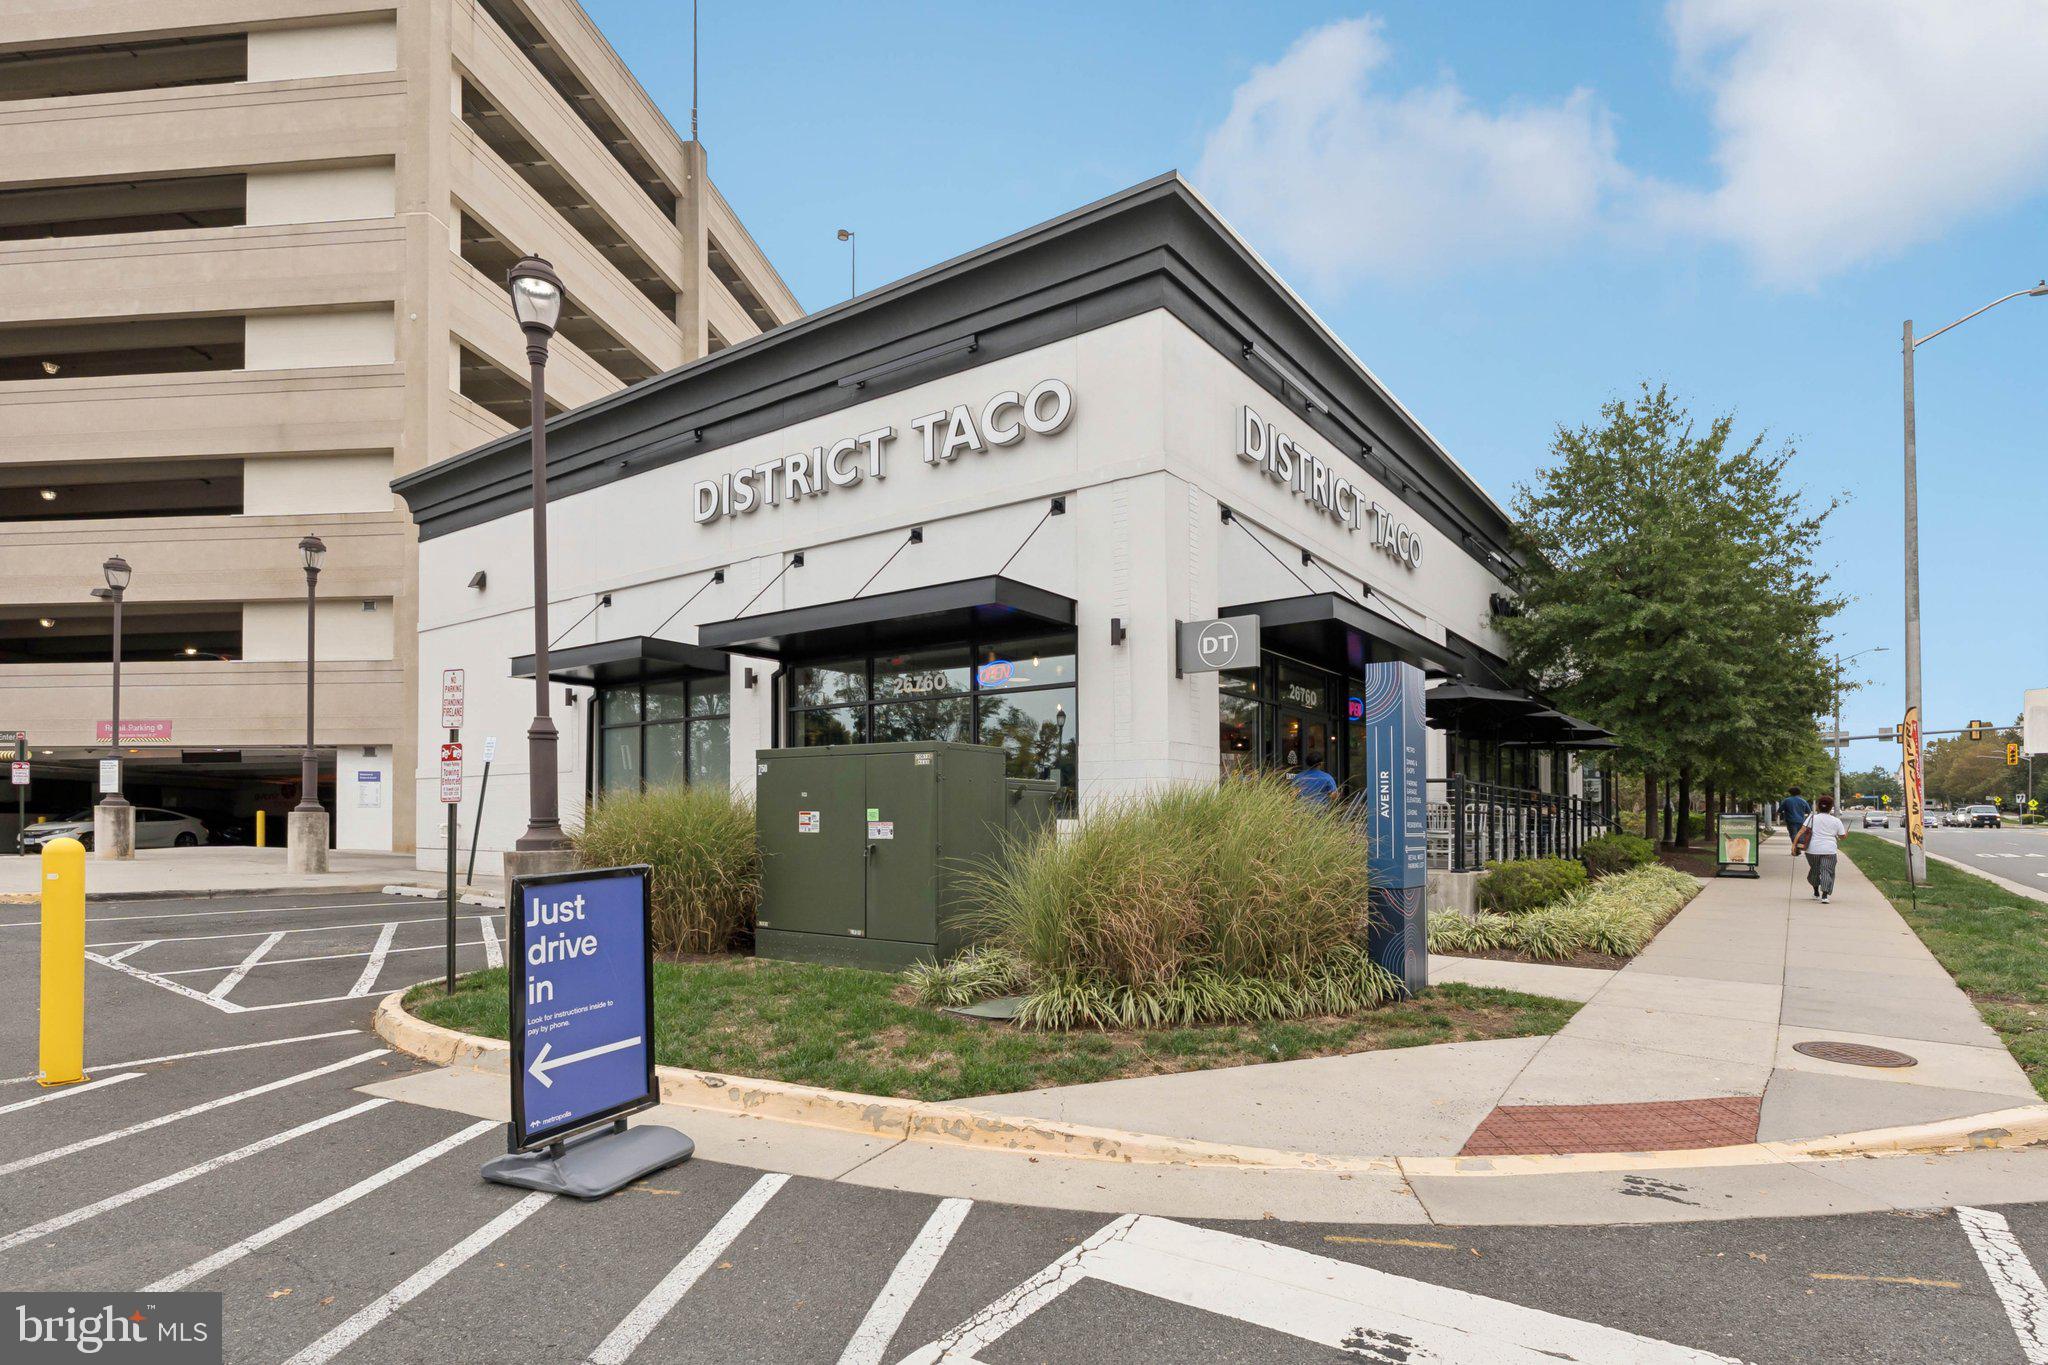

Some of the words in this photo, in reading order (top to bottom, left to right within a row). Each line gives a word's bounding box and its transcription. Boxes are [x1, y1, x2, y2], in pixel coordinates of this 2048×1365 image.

[693, 426, 897, 524] DISTRICT
[911, 378, 1077, 466] TACO
[1237, 405, 1366, 532] DISTRICT
[1366, 501, 1424, 569] TACO
[1202, 635, 1233, 654] DT
[444, 685, 463, 693] PARKING
[450, 676, 457, 684] NO
[893, 673, 947, 694] 26760
[1289, 684, 1317, 706] 26760
[442, 707, 463, 717] FIRELANE
[128, 723, 156, 733] Parking
[442, 778, 461, 786] Enforced
[443, 769, 460, 778] Towing
[1380, 771, 1390, 818] AVENIR
[527, 894, 586, 928] Just
[528, 933, 597, 966] drive
[528, 976, 554, 1005] in
[527, 1016, 543, 1026] Look
[554, 1005, 589, 1019] instructions
[589, 1001, 607, 1011] inside
[527, 1027, 540, 1037] pay
[540, 1025, 549, 1033] by
[549, 1020, 570, 1031] phone.
[542, 1110, 572, 1125] metropolis
